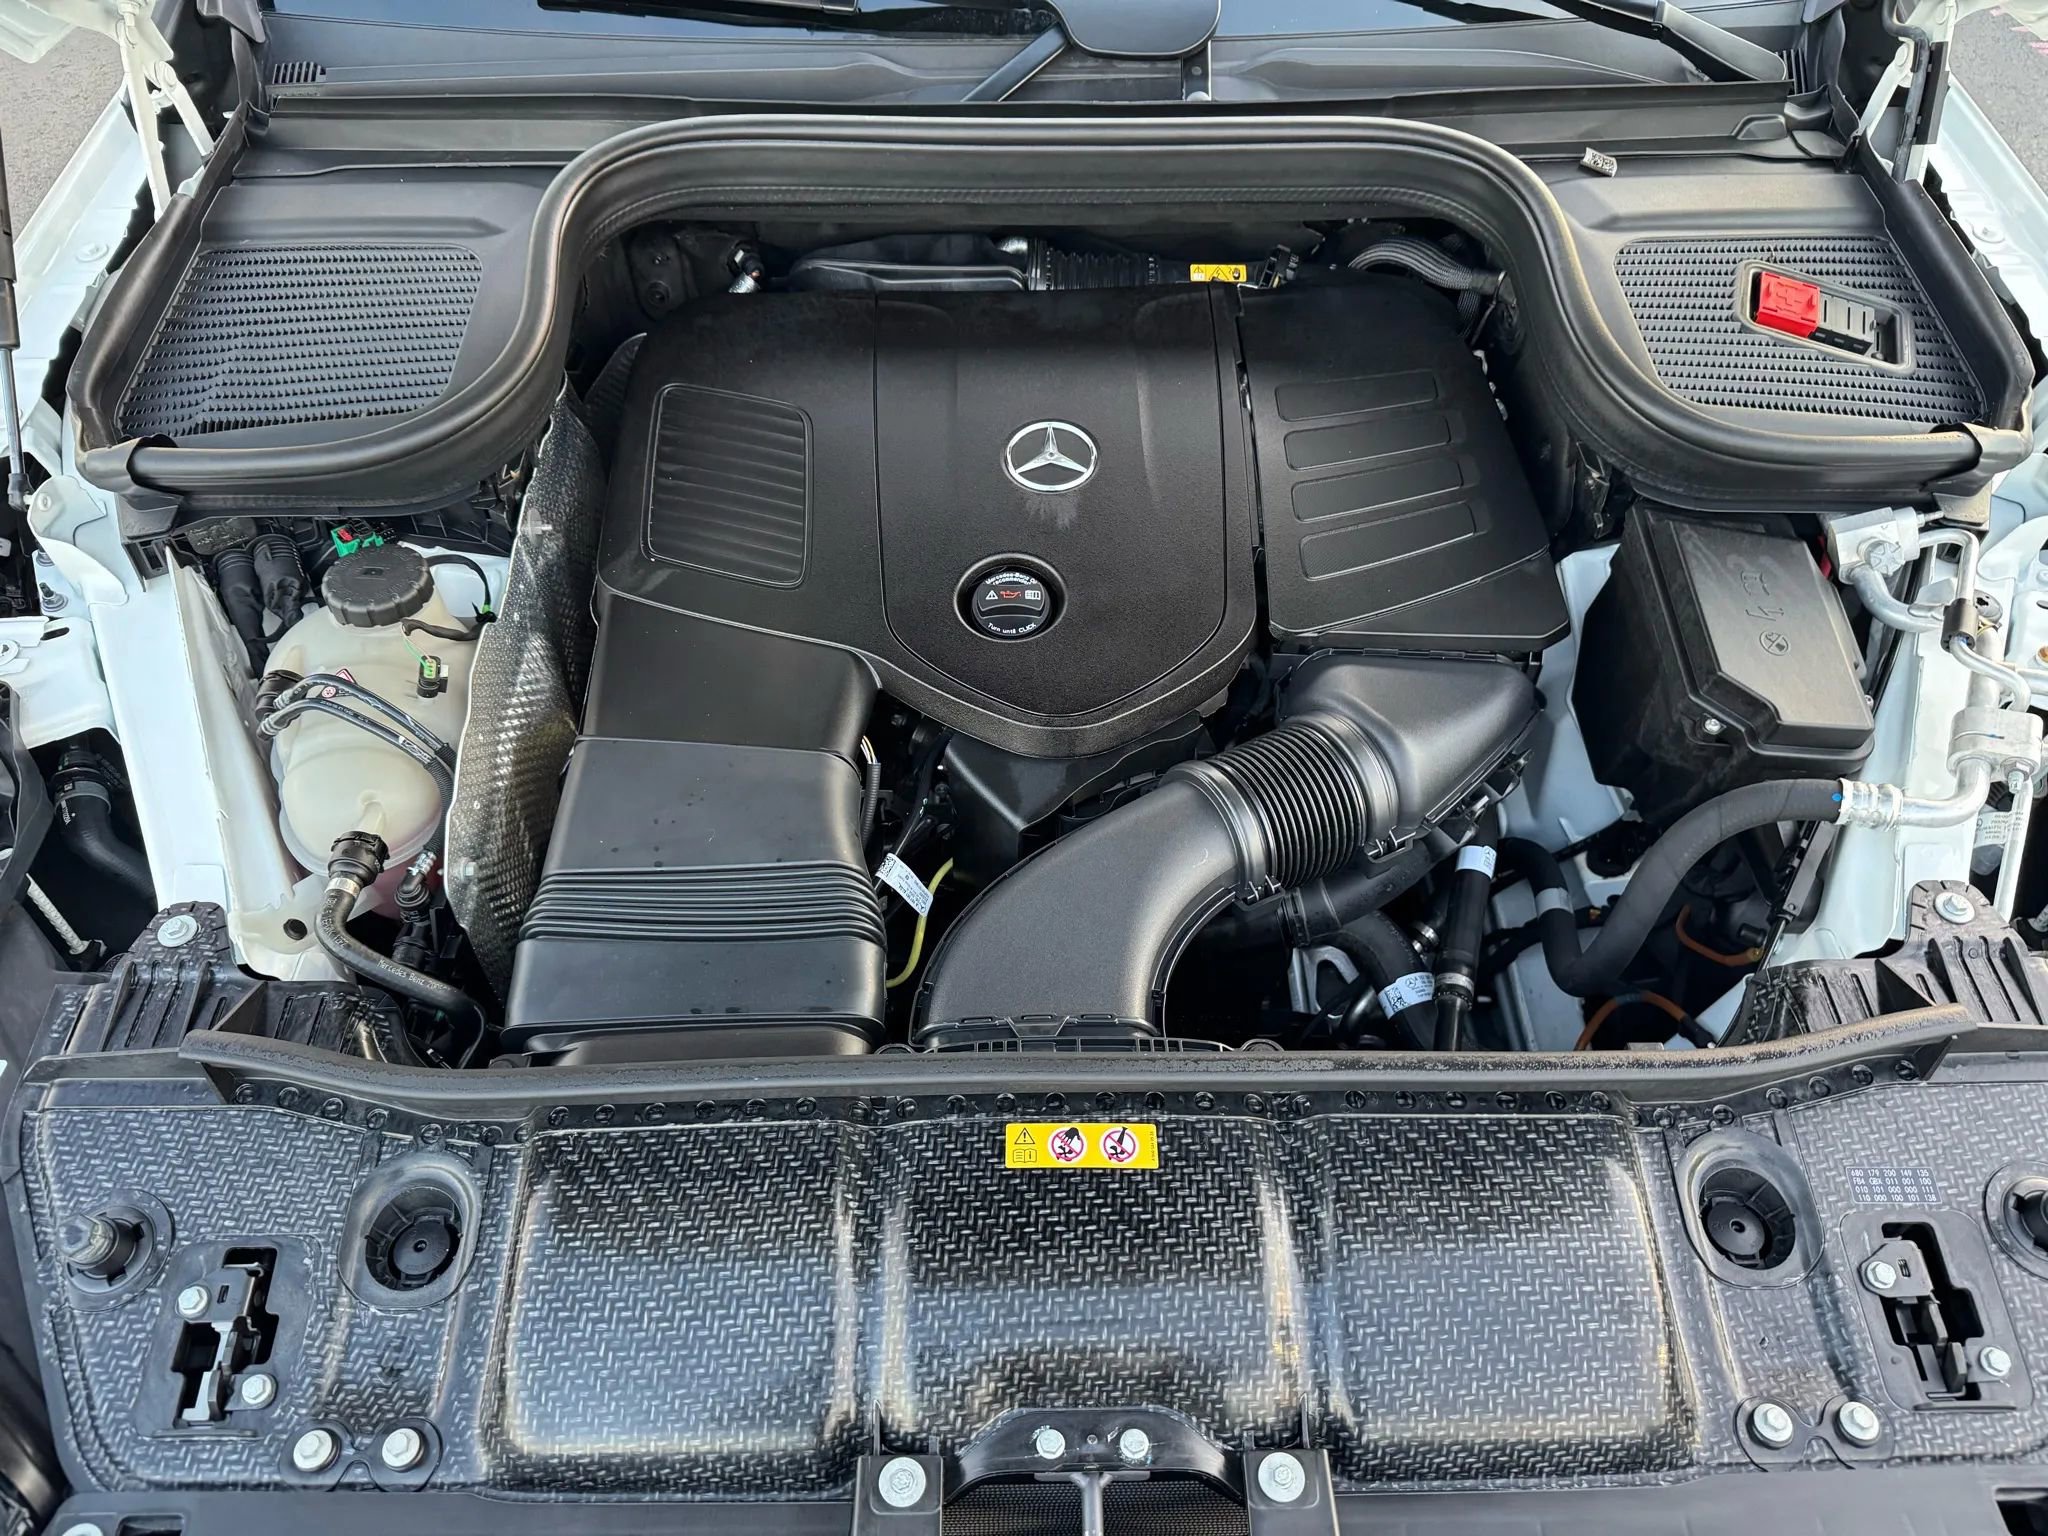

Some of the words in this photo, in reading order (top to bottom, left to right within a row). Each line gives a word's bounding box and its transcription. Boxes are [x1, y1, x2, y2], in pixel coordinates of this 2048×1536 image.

[985, 572, 1030, 585] Mercedes-Benz
[987, 622, 1001, 632] Turn
[1018, 622, 1037, 633] CLICK
[377, 959, 407, 978] Mercedes
[408, 972, 425, 986] Benz
[1851, 1169, 1864, 1177] 680
[1867, 1169, 1880, 1177] 179
[1883, 1169, 1896, 1177] 200
[1885, 1177, 1899, 1185] 011
[1901, 1177, 1915, 1185] 001
[1919, 1177, 1932, 1185] 100
